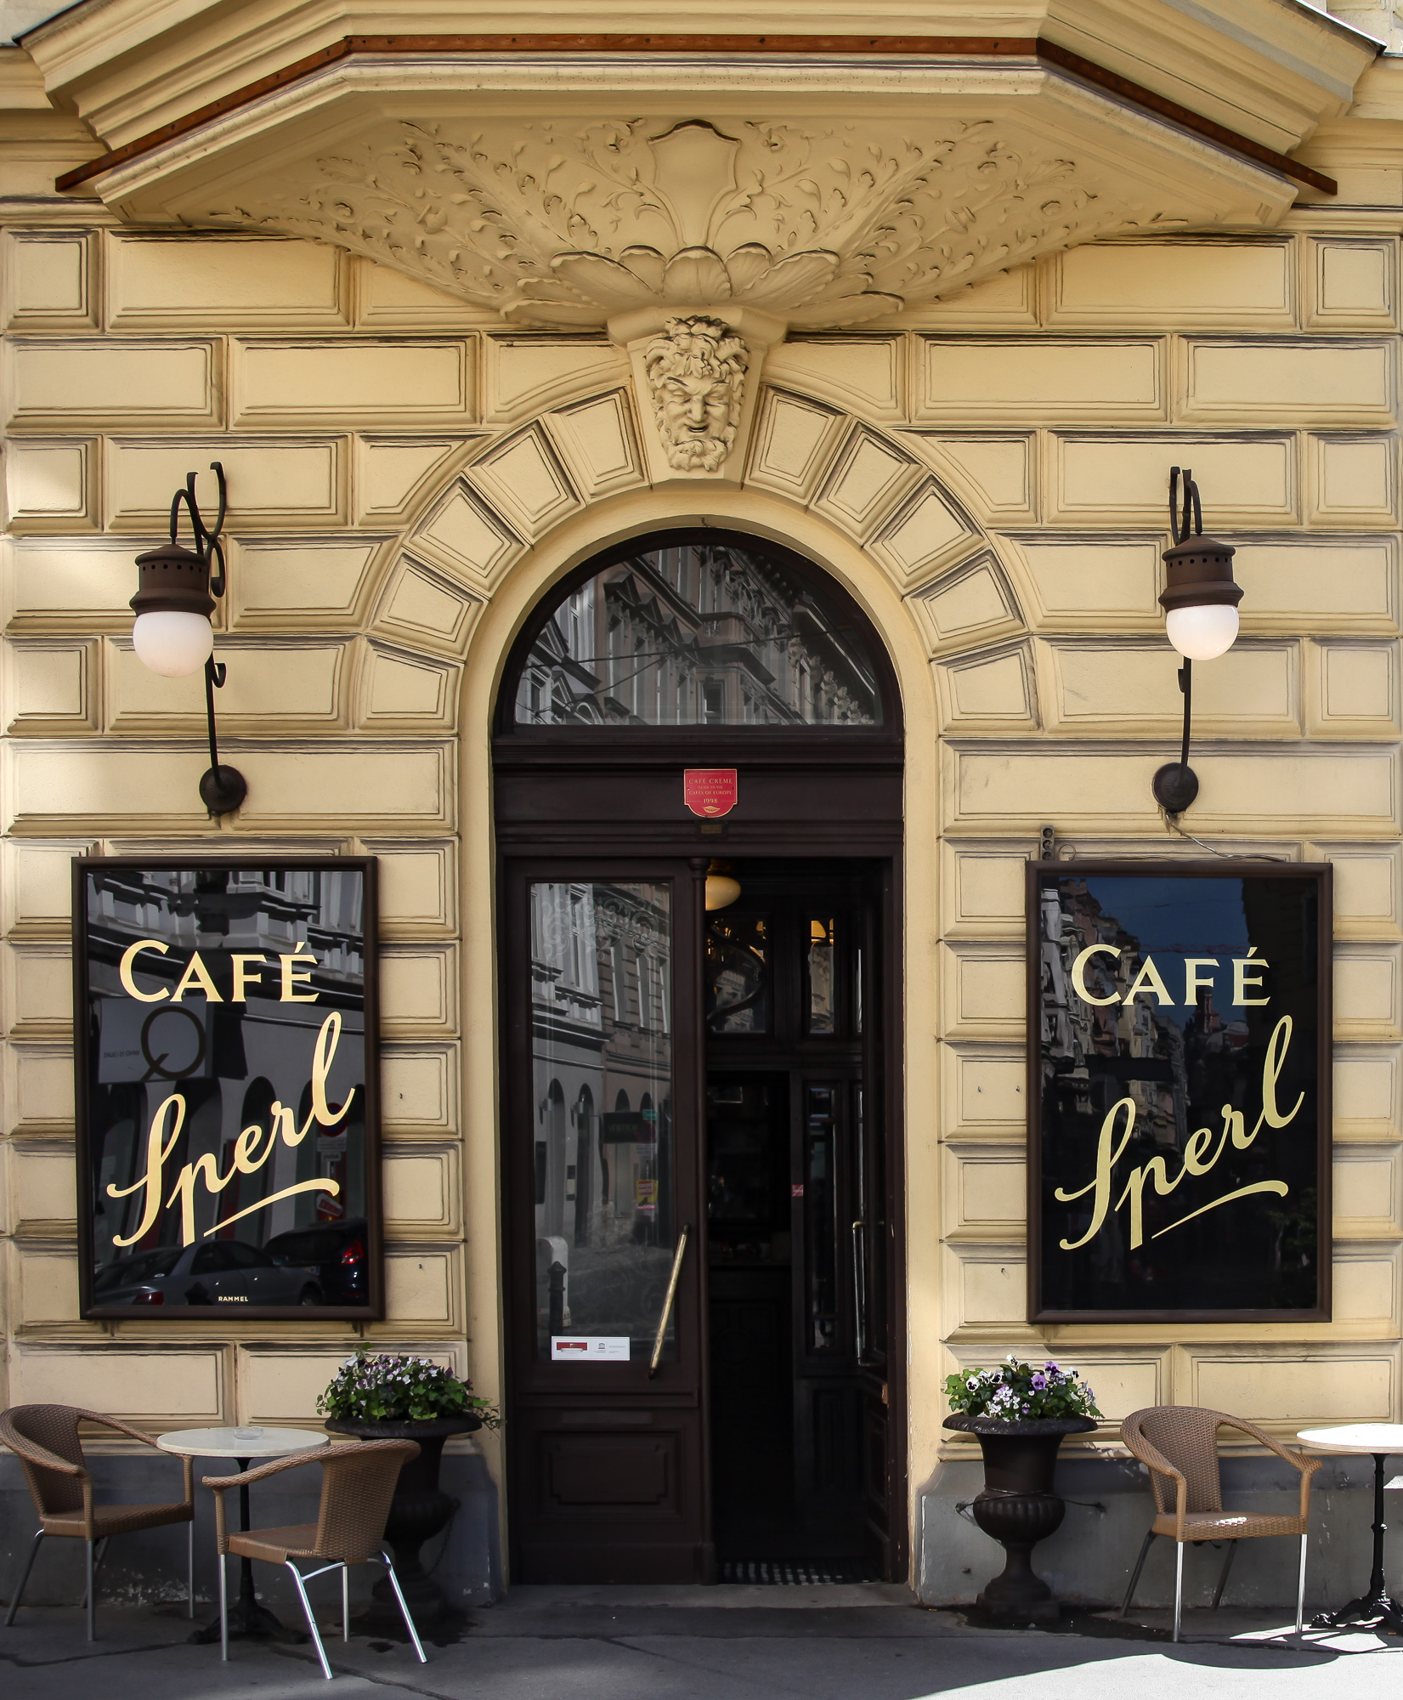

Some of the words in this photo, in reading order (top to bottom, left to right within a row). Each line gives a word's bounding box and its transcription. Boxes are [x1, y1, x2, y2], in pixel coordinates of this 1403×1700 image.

[119, 940, 320, 1003] CAFÉ
[1071, 944, 1271, 1007] CAFÉ
[106, 1011, 356, 1247] Sperl
[1054, 1014, 1305, 1250] Sperl
